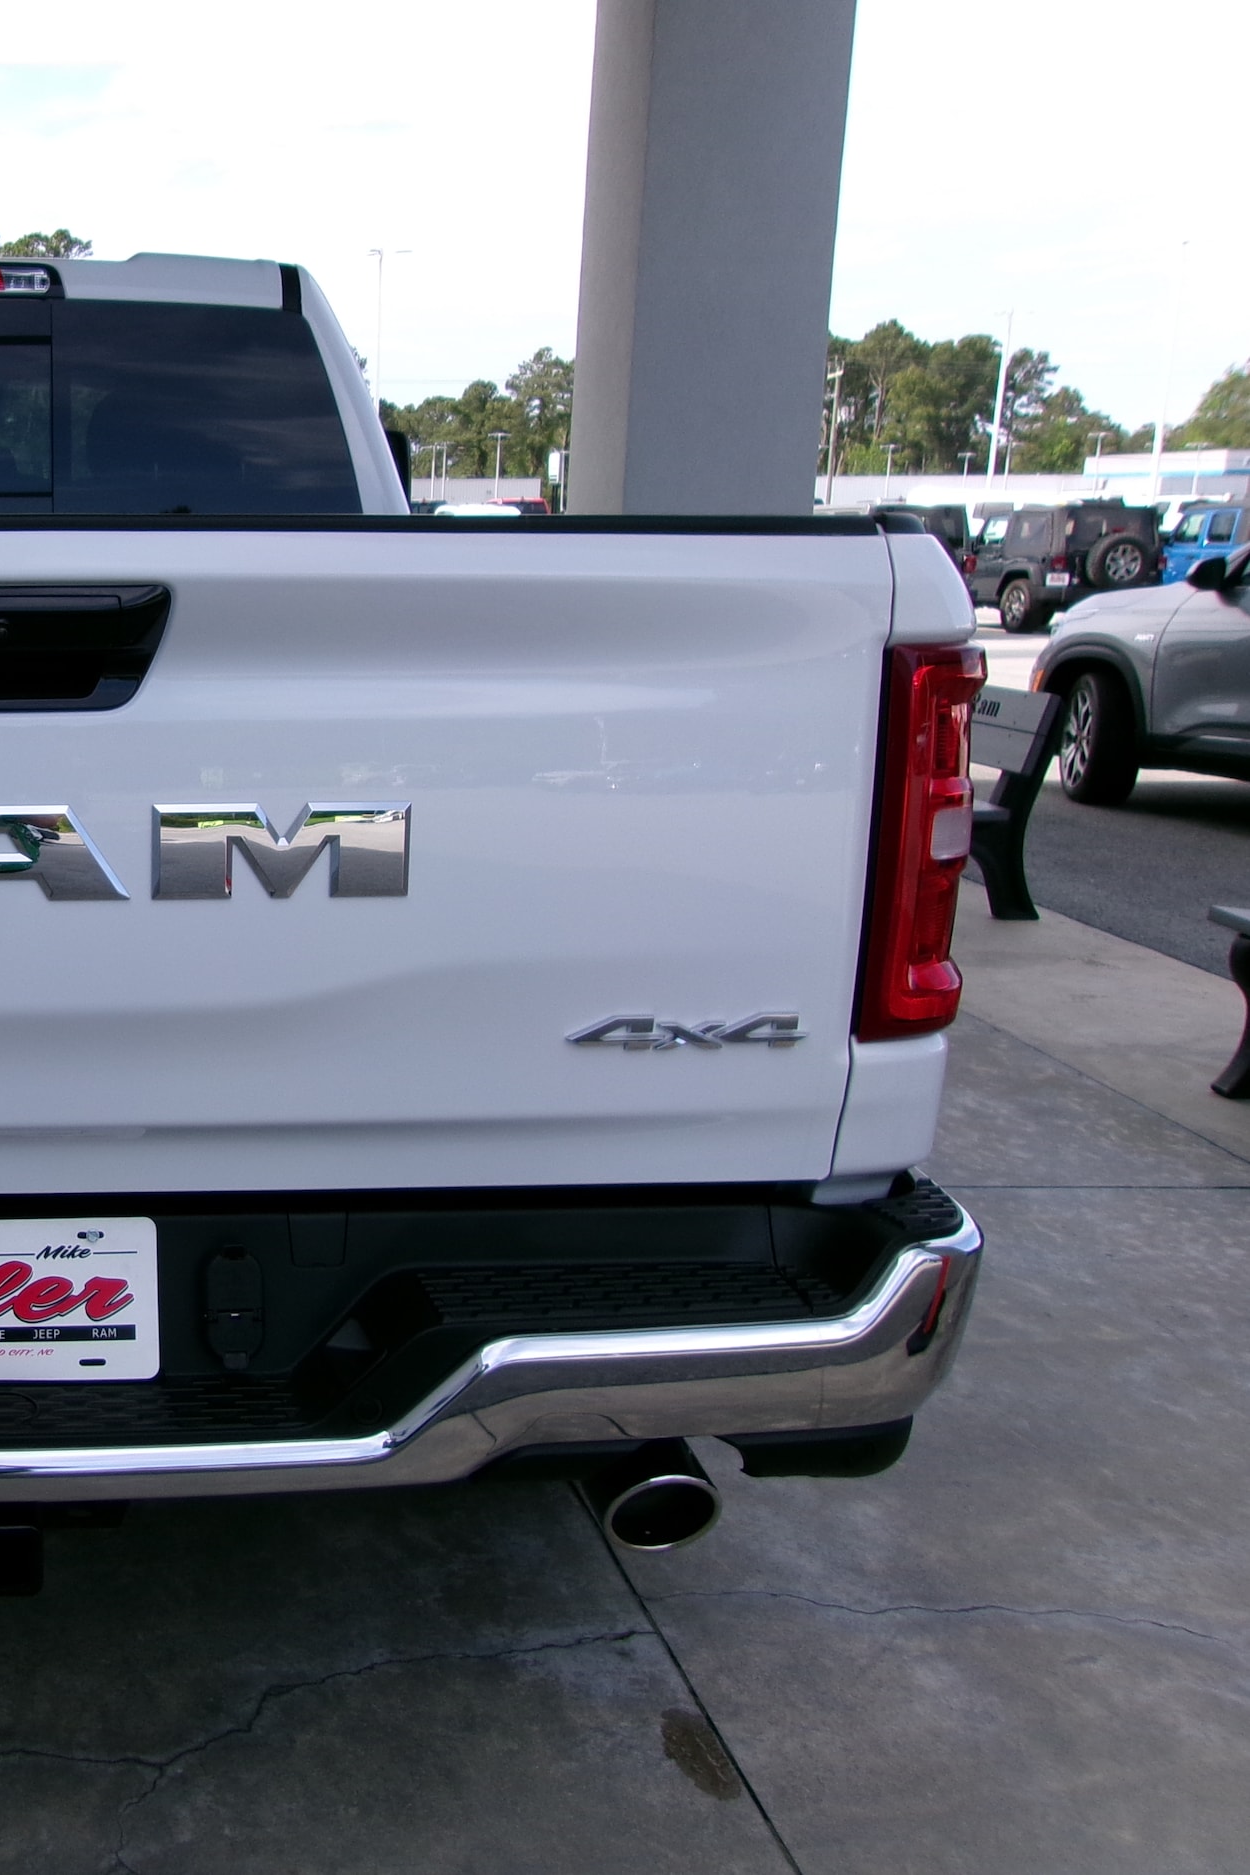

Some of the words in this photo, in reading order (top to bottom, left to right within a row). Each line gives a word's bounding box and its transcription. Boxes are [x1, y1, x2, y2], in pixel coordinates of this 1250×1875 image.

[36, 1245, 92, 1261] Mike
[33, 1328, 60, 1340] JEEP
[91, 1327, 117, 1339] RAM
[37, 1348, 55, 1357] NC
